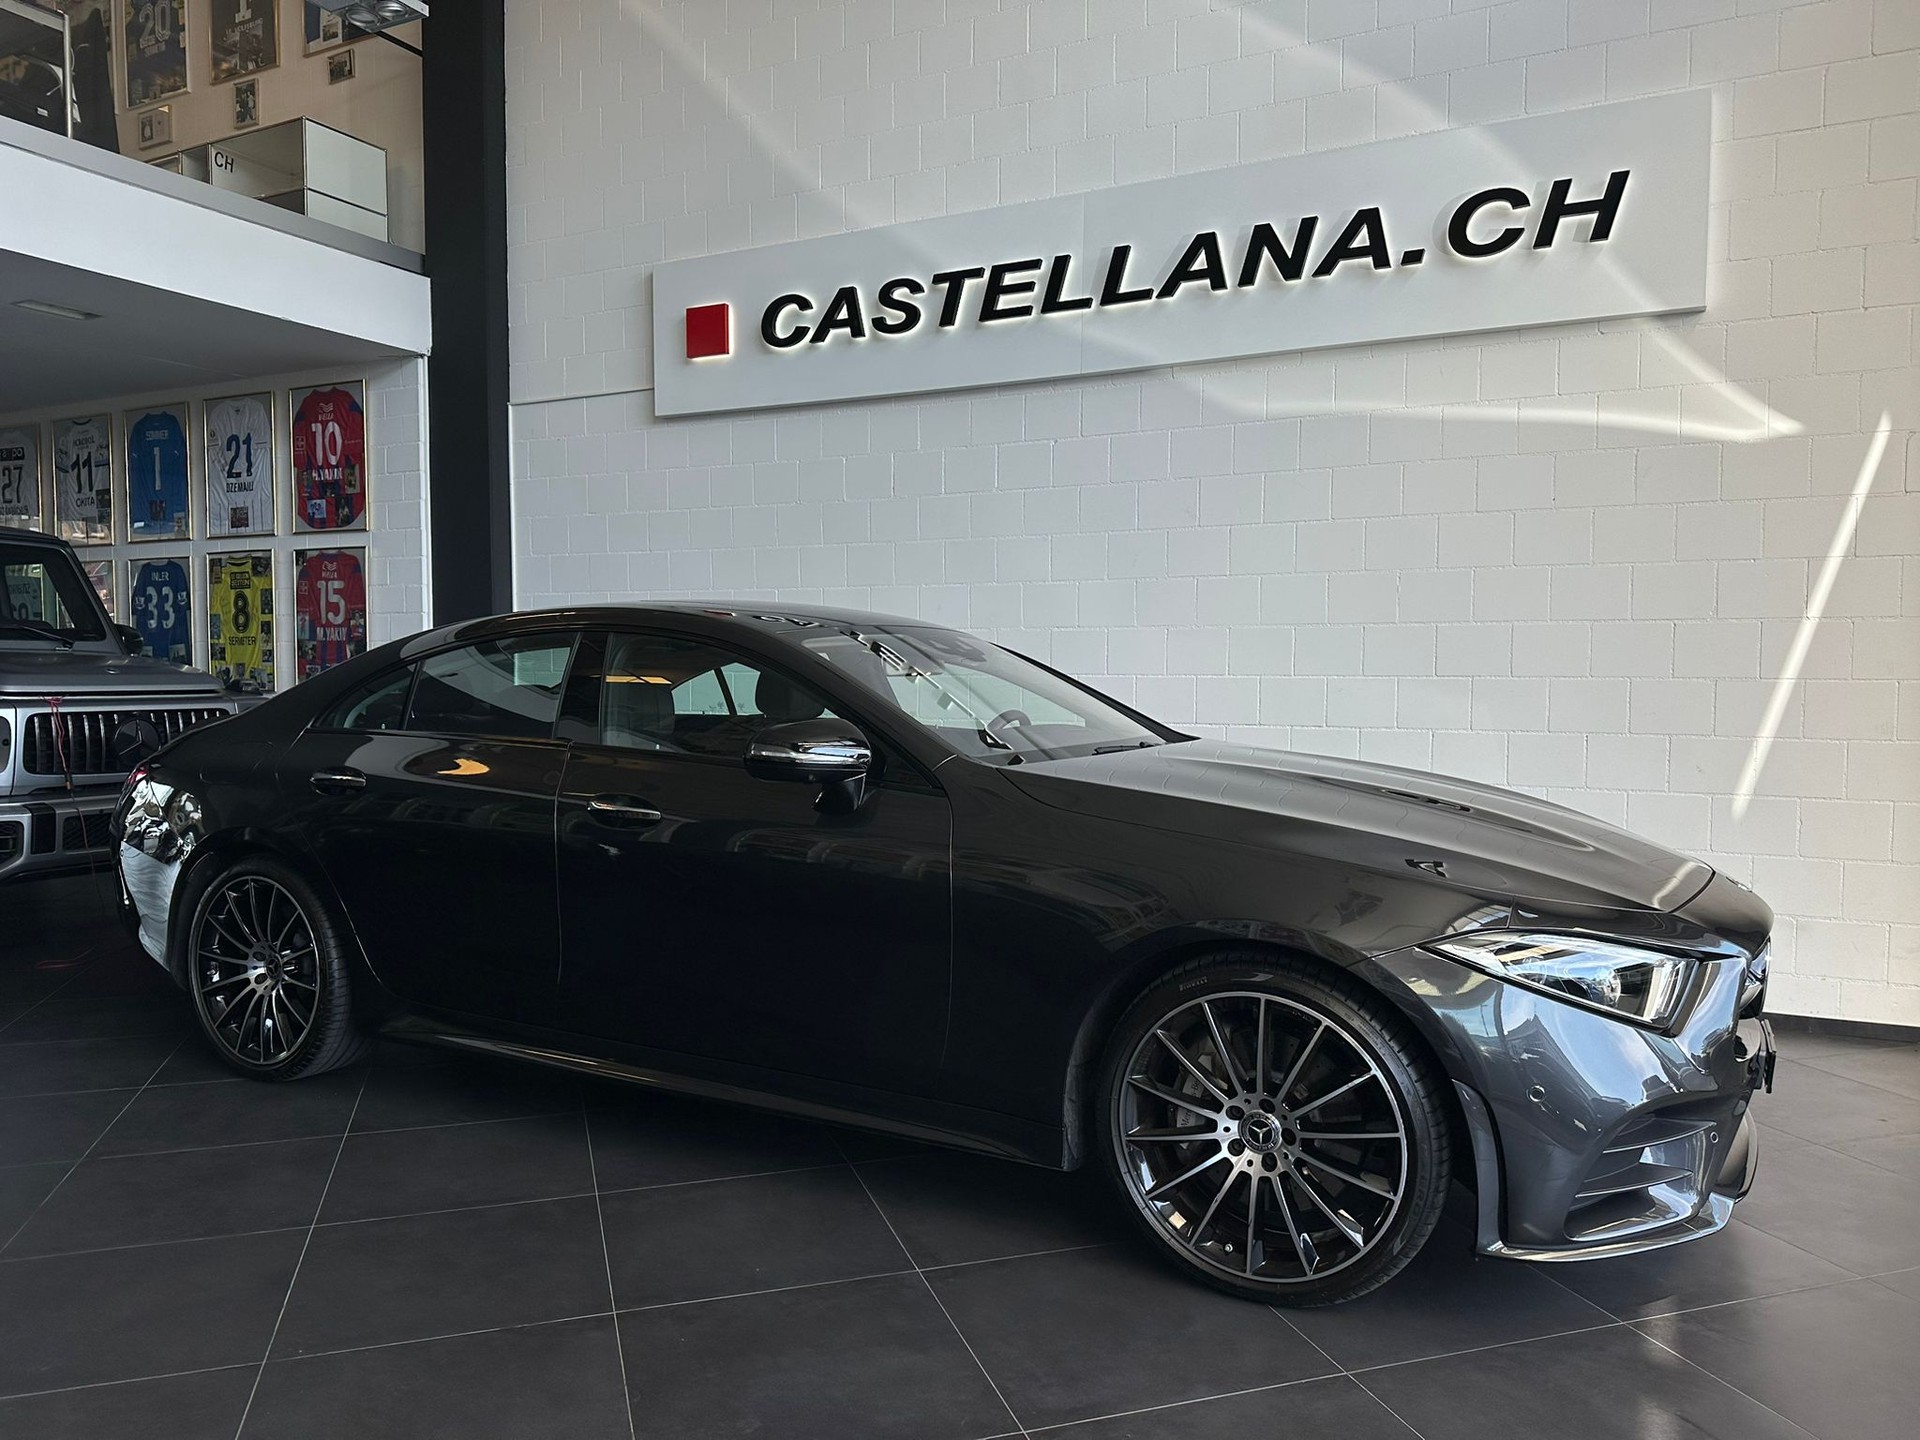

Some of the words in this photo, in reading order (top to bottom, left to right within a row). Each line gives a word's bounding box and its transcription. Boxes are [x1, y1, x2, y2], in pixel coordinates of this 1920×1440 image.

[214, 151, 234, 173] CH
[760, 169, 1631, 349] CASTELLANA.CH
[226, 432, 252, 478] 21
[311, 421, 342, 466] 10
[2, 465, 23, 504] 27
[70, 451, 94, 494] 11
[153, 446, 161, 490] 1
[146, 586, 175, 629] 33
[231, 590, 251, 634] 8
[317, 580, 346, 625] 15
